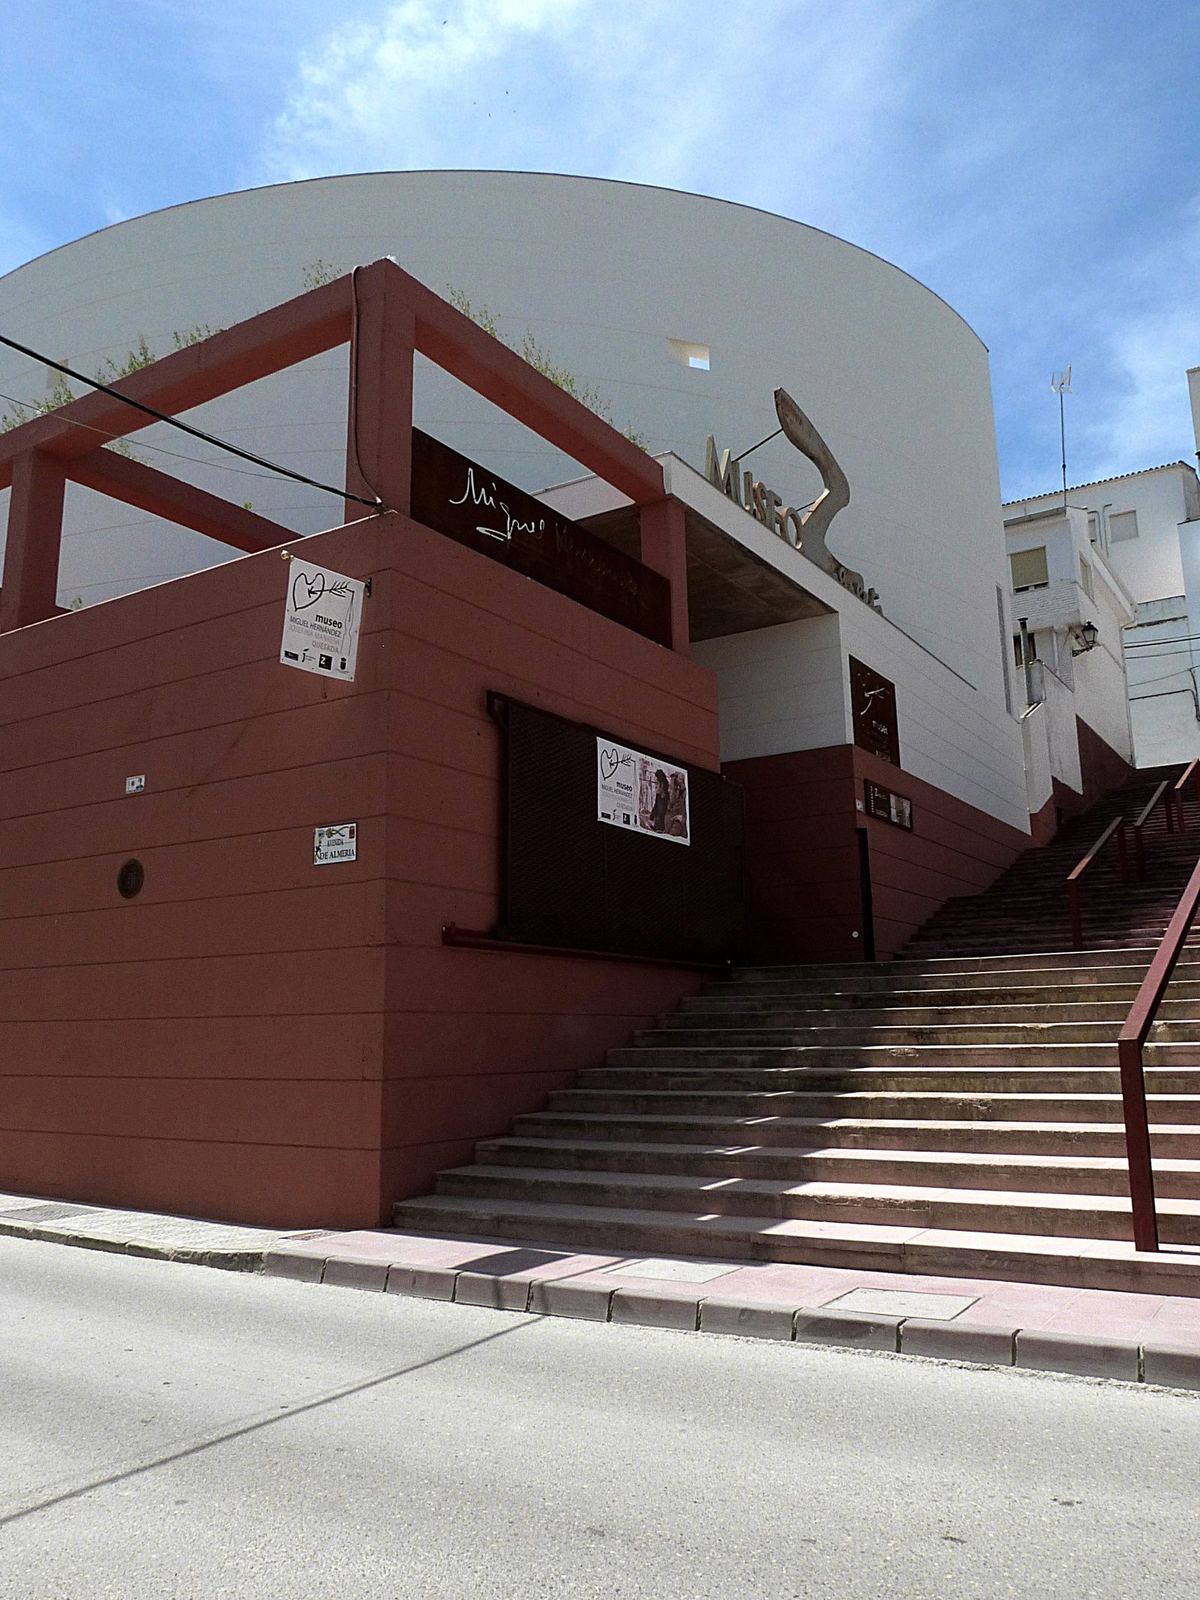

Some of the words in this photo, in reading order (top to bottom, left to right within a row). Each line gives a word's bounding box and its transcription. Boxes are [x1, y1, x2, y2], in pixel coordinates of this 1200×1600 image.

[289, 615, 309, 628] MIGUEL
[315, 614, 342, 629] museo
[311, 640, 340, 654] QUESADA
[320, 852, 328, 860] DE
